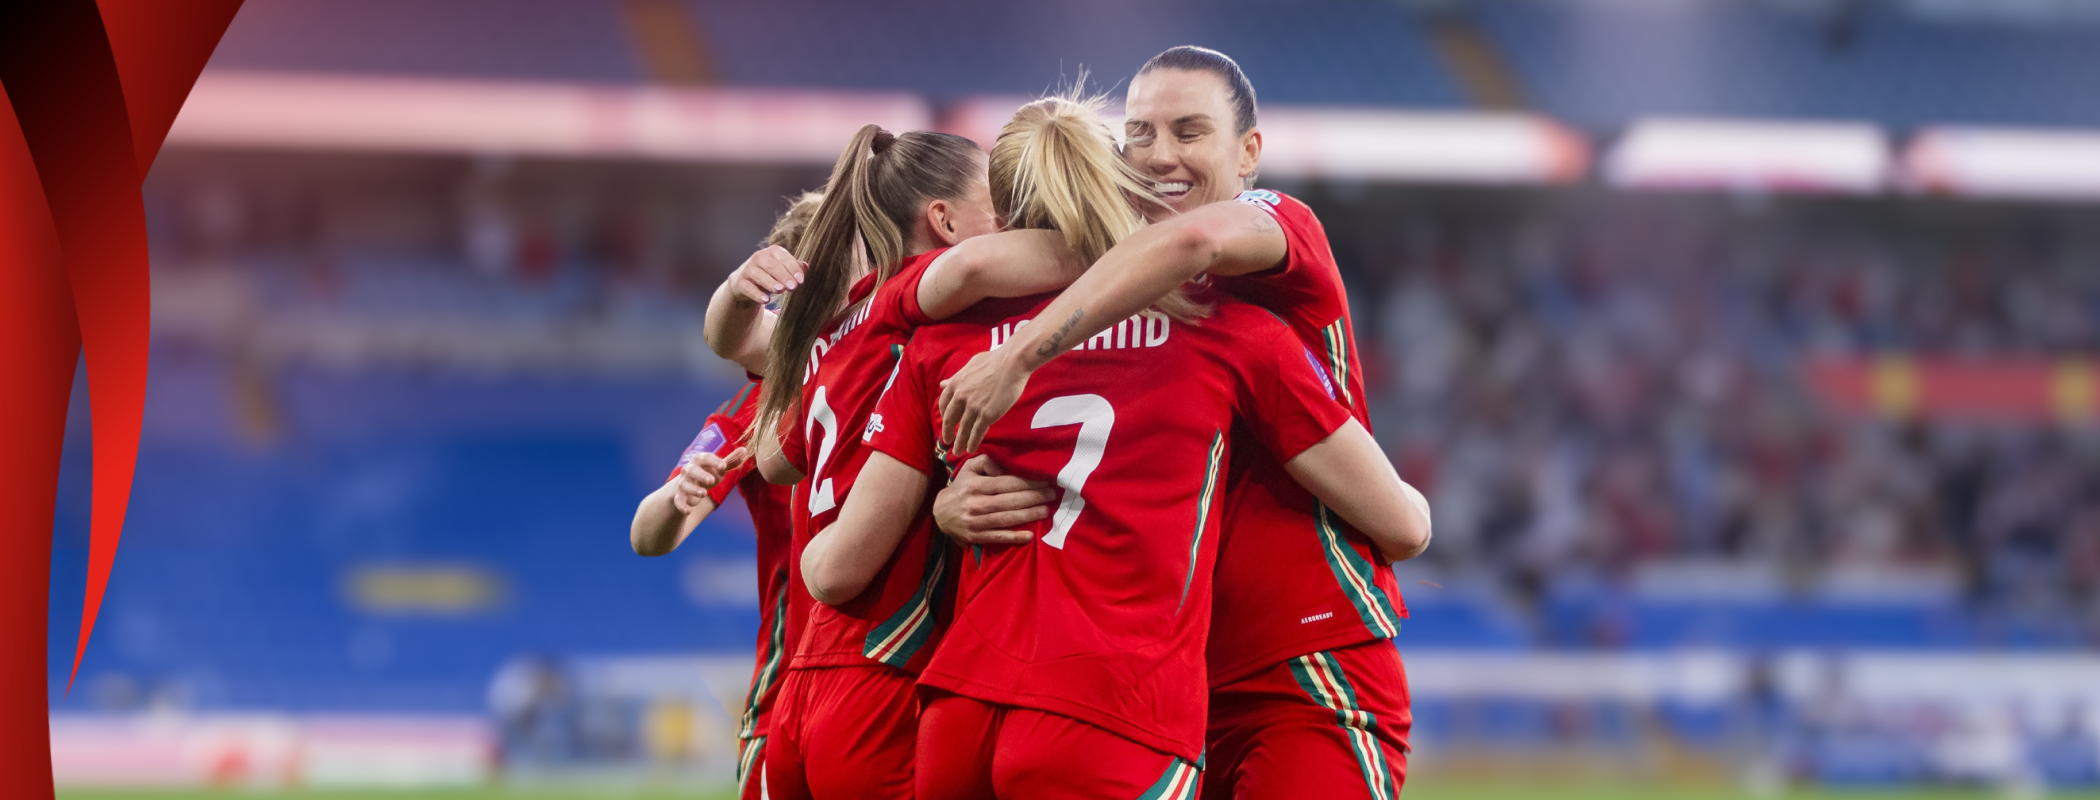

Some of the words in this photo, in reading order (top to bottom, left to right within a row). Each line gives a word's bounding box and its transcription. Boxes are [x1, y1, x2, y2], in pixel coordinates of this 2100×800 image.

[806, 385, 837, 518] 2
[1031, 393, 1115, 550] 7
[1300, 611, 1333, 624] AEROREADY
